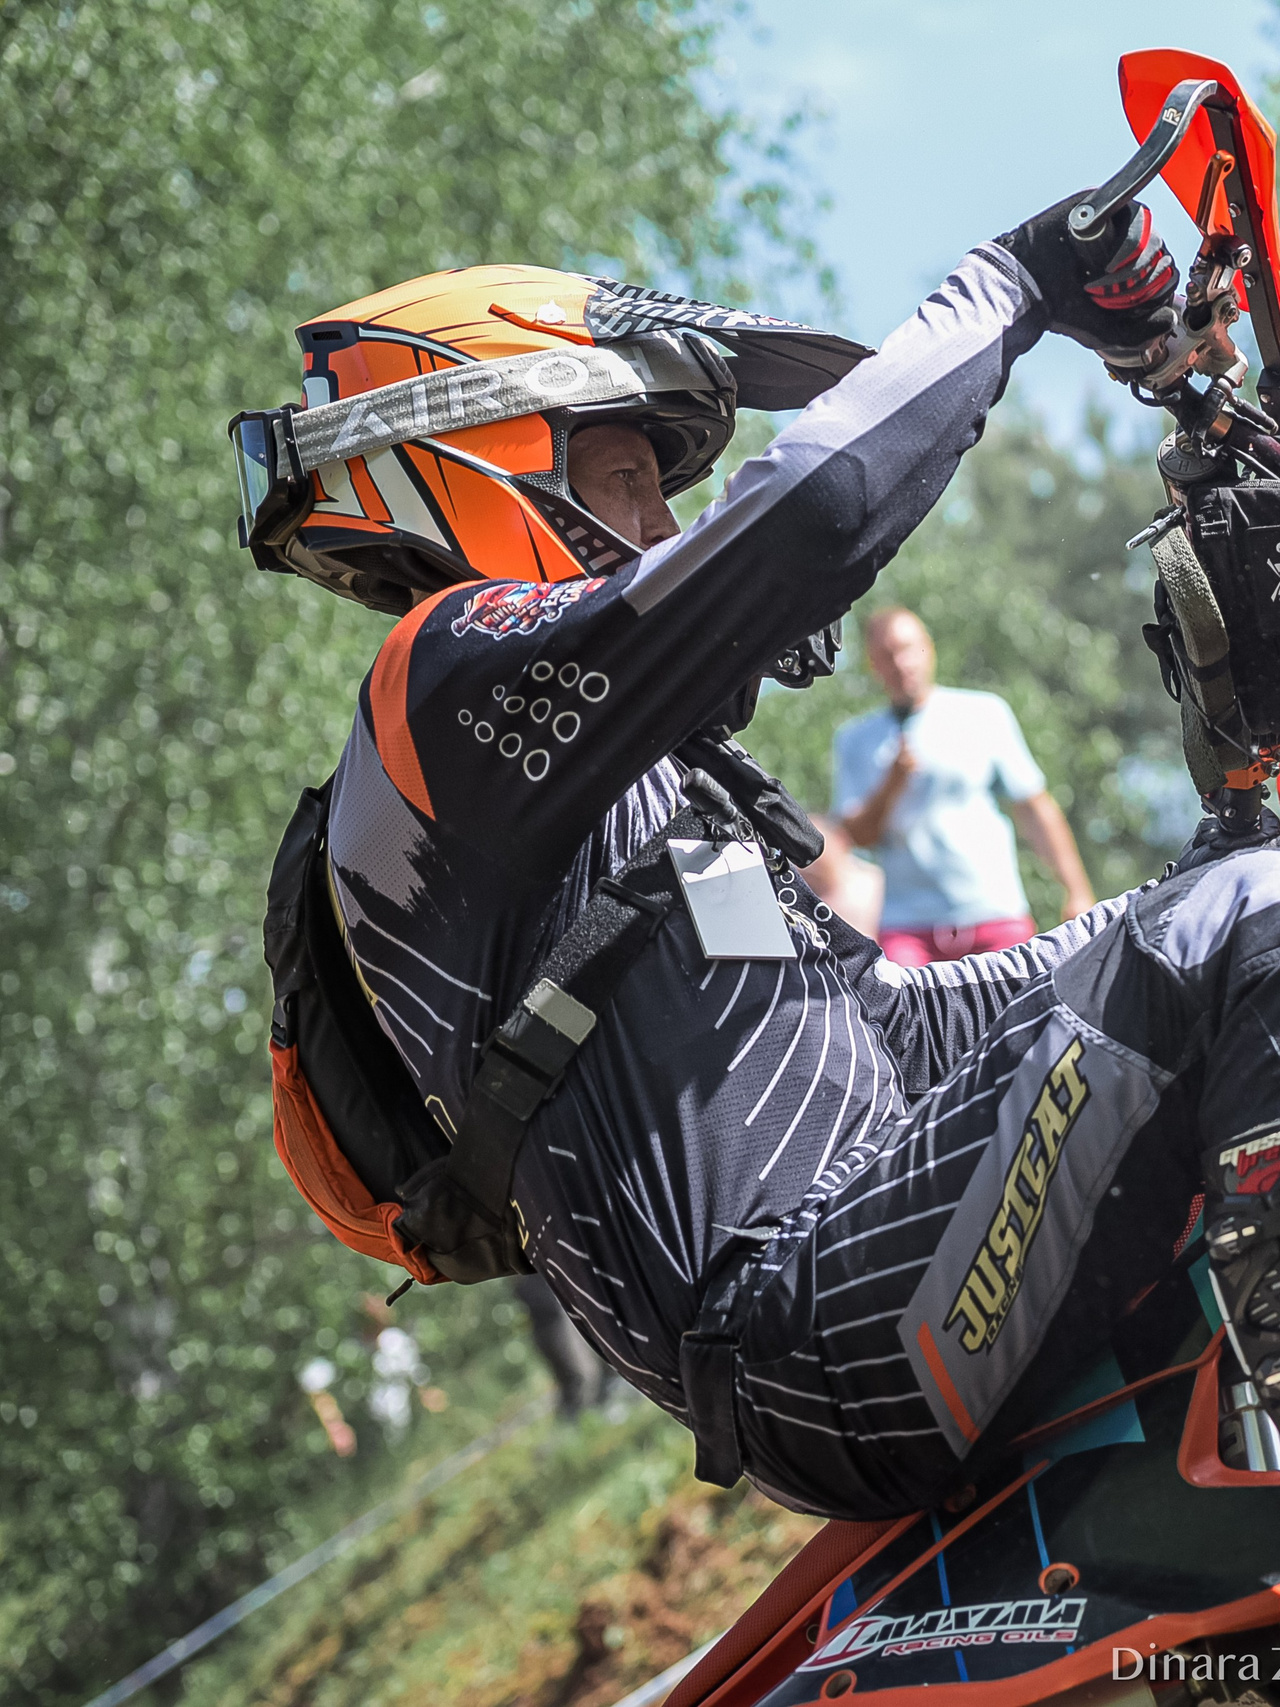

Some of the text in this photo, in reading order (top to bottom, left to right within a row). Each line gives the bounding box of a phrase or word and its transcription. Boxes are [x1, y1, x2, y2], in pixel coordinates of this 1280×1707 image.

[330, 345, 656, 452] AIROH
[945, 1037, 1091, 1352] JUSTCAT
[881, 1628, 1078, 1657] RACING OILS
